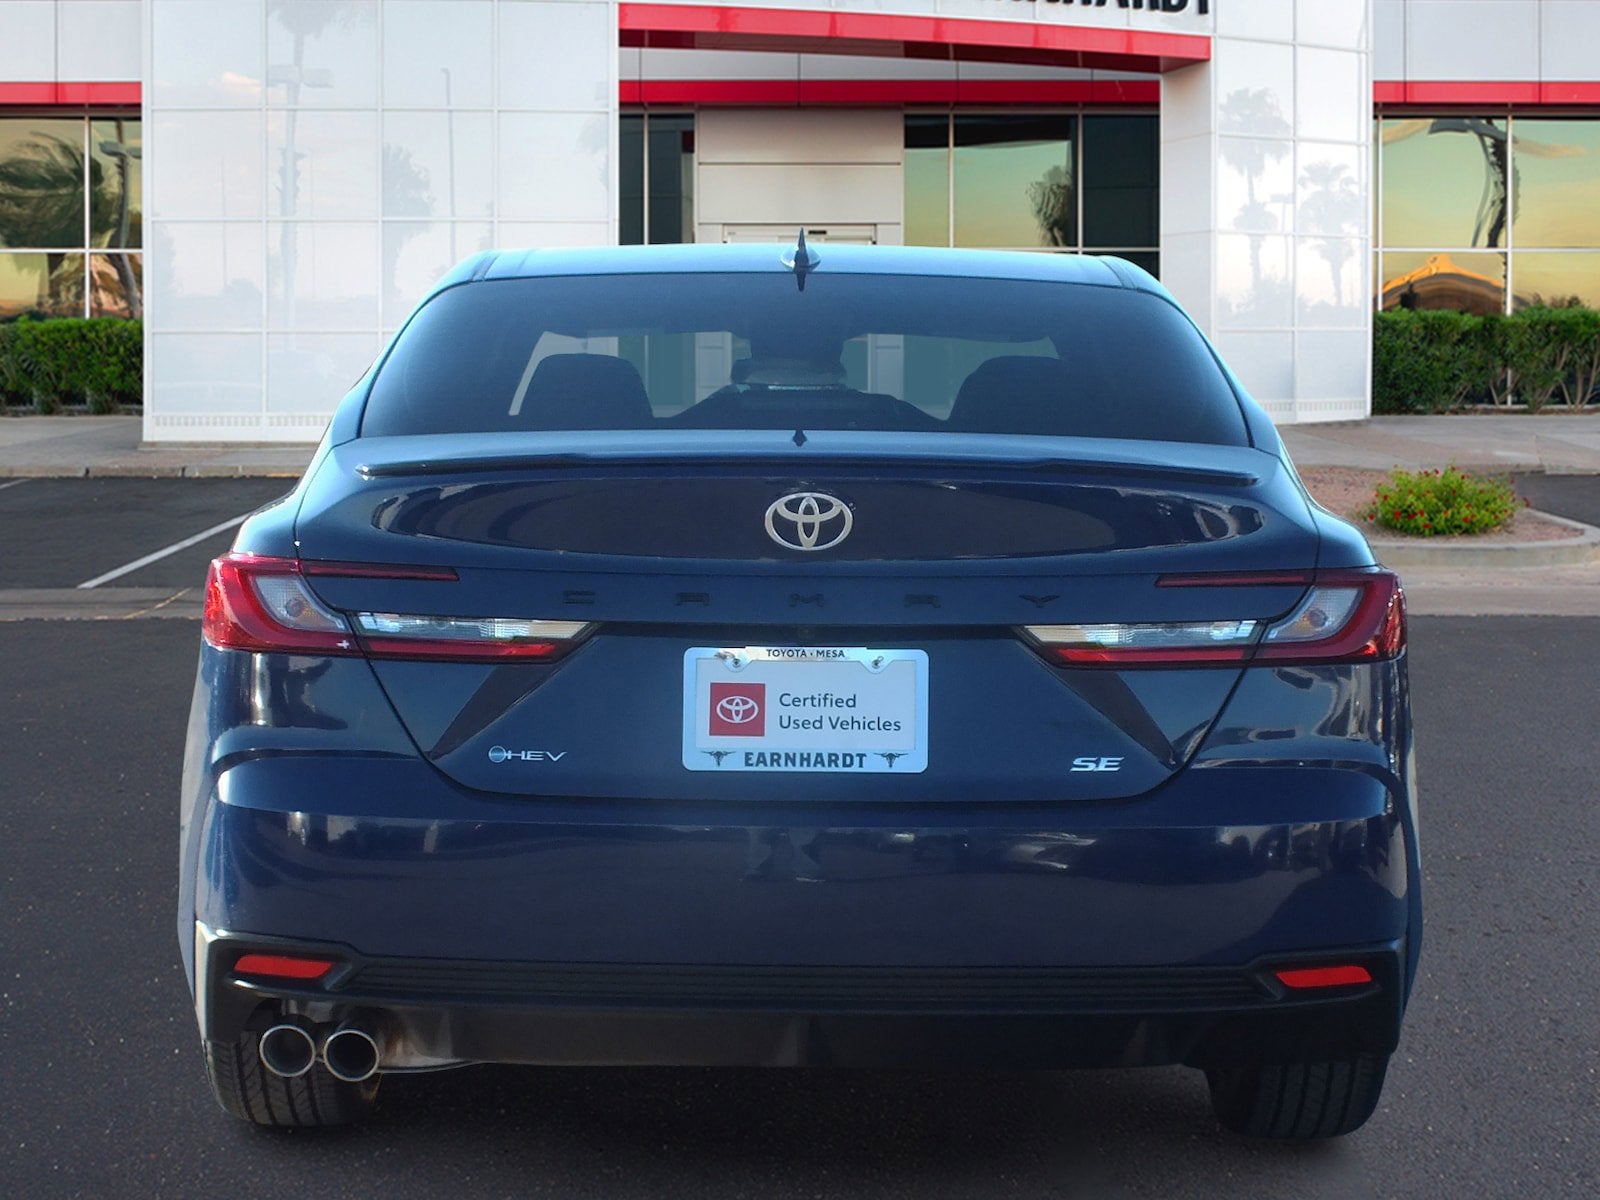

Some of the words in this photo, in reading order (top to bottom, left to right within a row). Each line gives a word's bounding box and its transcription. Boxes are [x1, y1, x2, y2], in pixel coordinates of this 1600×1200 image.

[766, 649, 807, 658] TOYOTA
[816, 650, 845, 658] MESA
[779, 692, 857, 708] Certified
[779, 715, 823, 730] Used
[828, 716, 901, 731] Vehicles
[506, 749, 567, 762] HEV
[744, 751, 867, 768] EARNHARDT
[1070, 757, 1124, 772] SE
